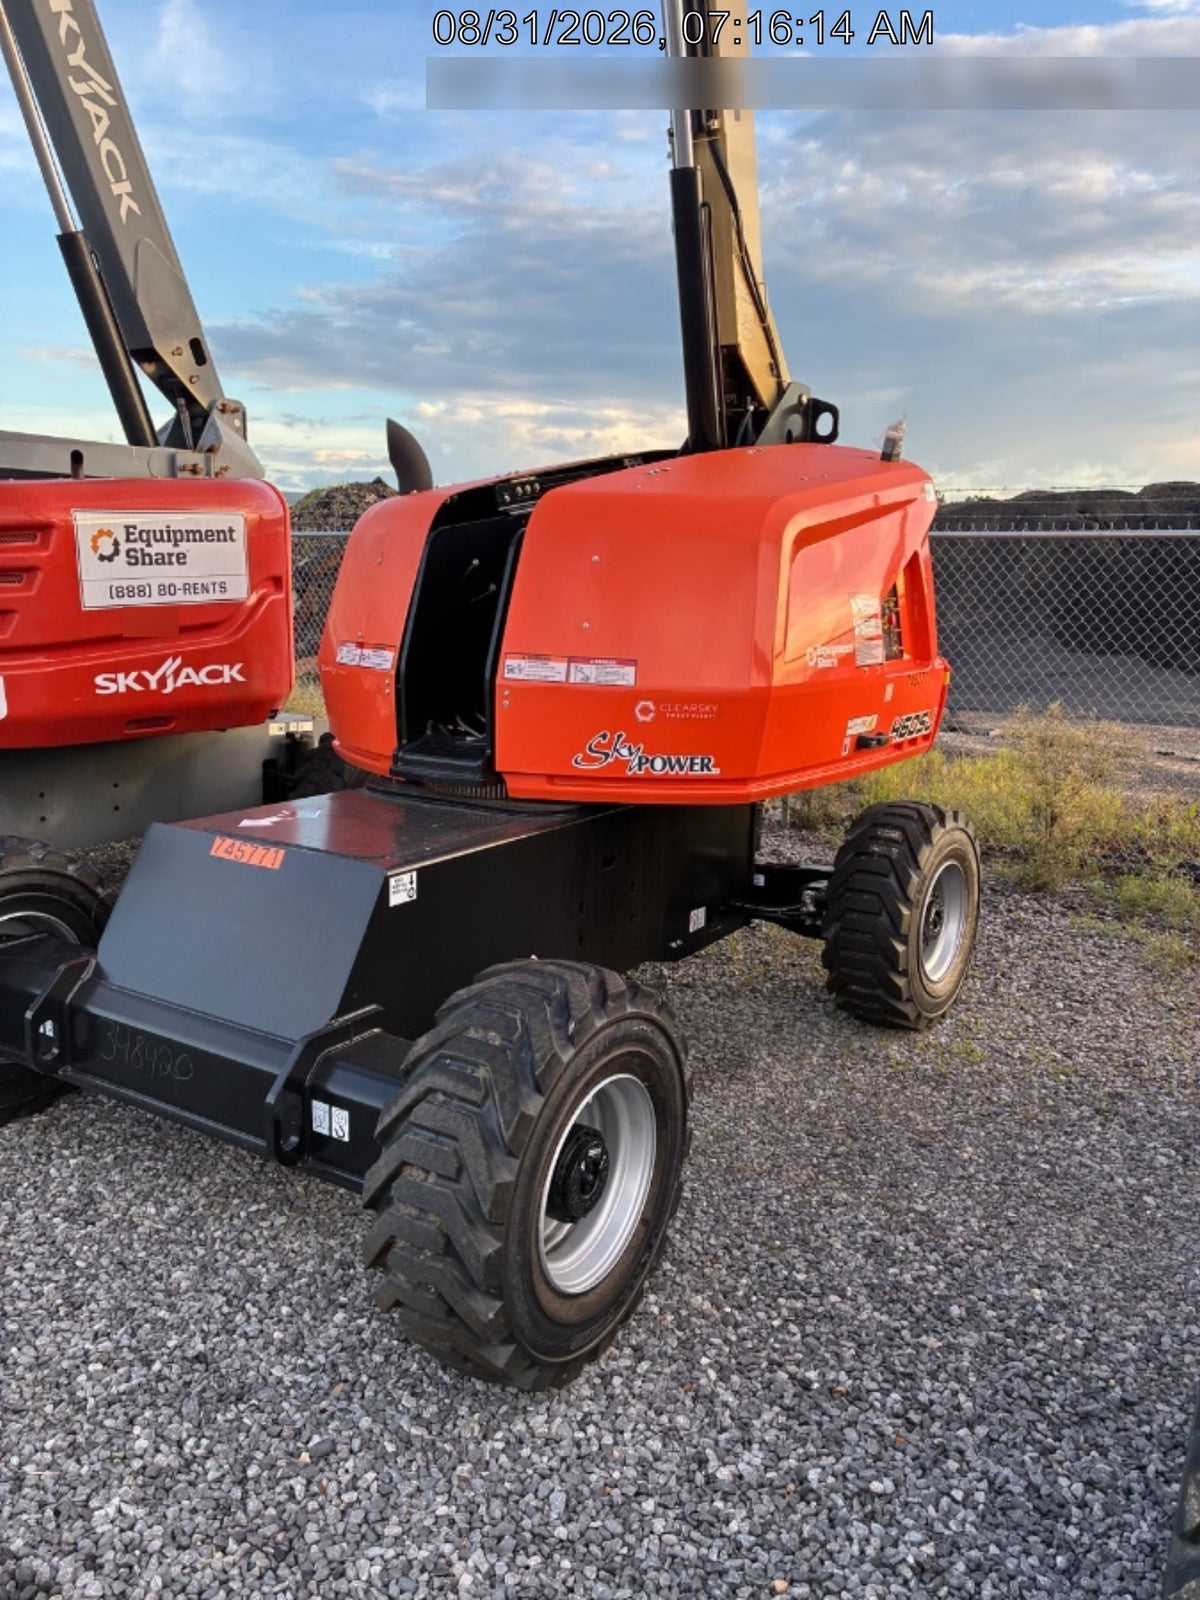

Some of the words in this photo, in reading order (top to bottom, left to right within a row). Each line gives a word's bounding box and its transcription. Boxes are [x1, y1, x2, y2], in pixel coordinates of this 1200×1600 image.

[123, 524, 237, 548] Equipment
[125, 547, 188, 566] Share
[109, 583, 152, 600] (888)
[157, 581, 228, 597] 80-RENTS
[94, 655, 247, 694] SKYJACK
[659, 703, 719, 713] CLEARSKY
[572, 731, 643, 775] Sky
[635, 754, 713, 775] POWER
